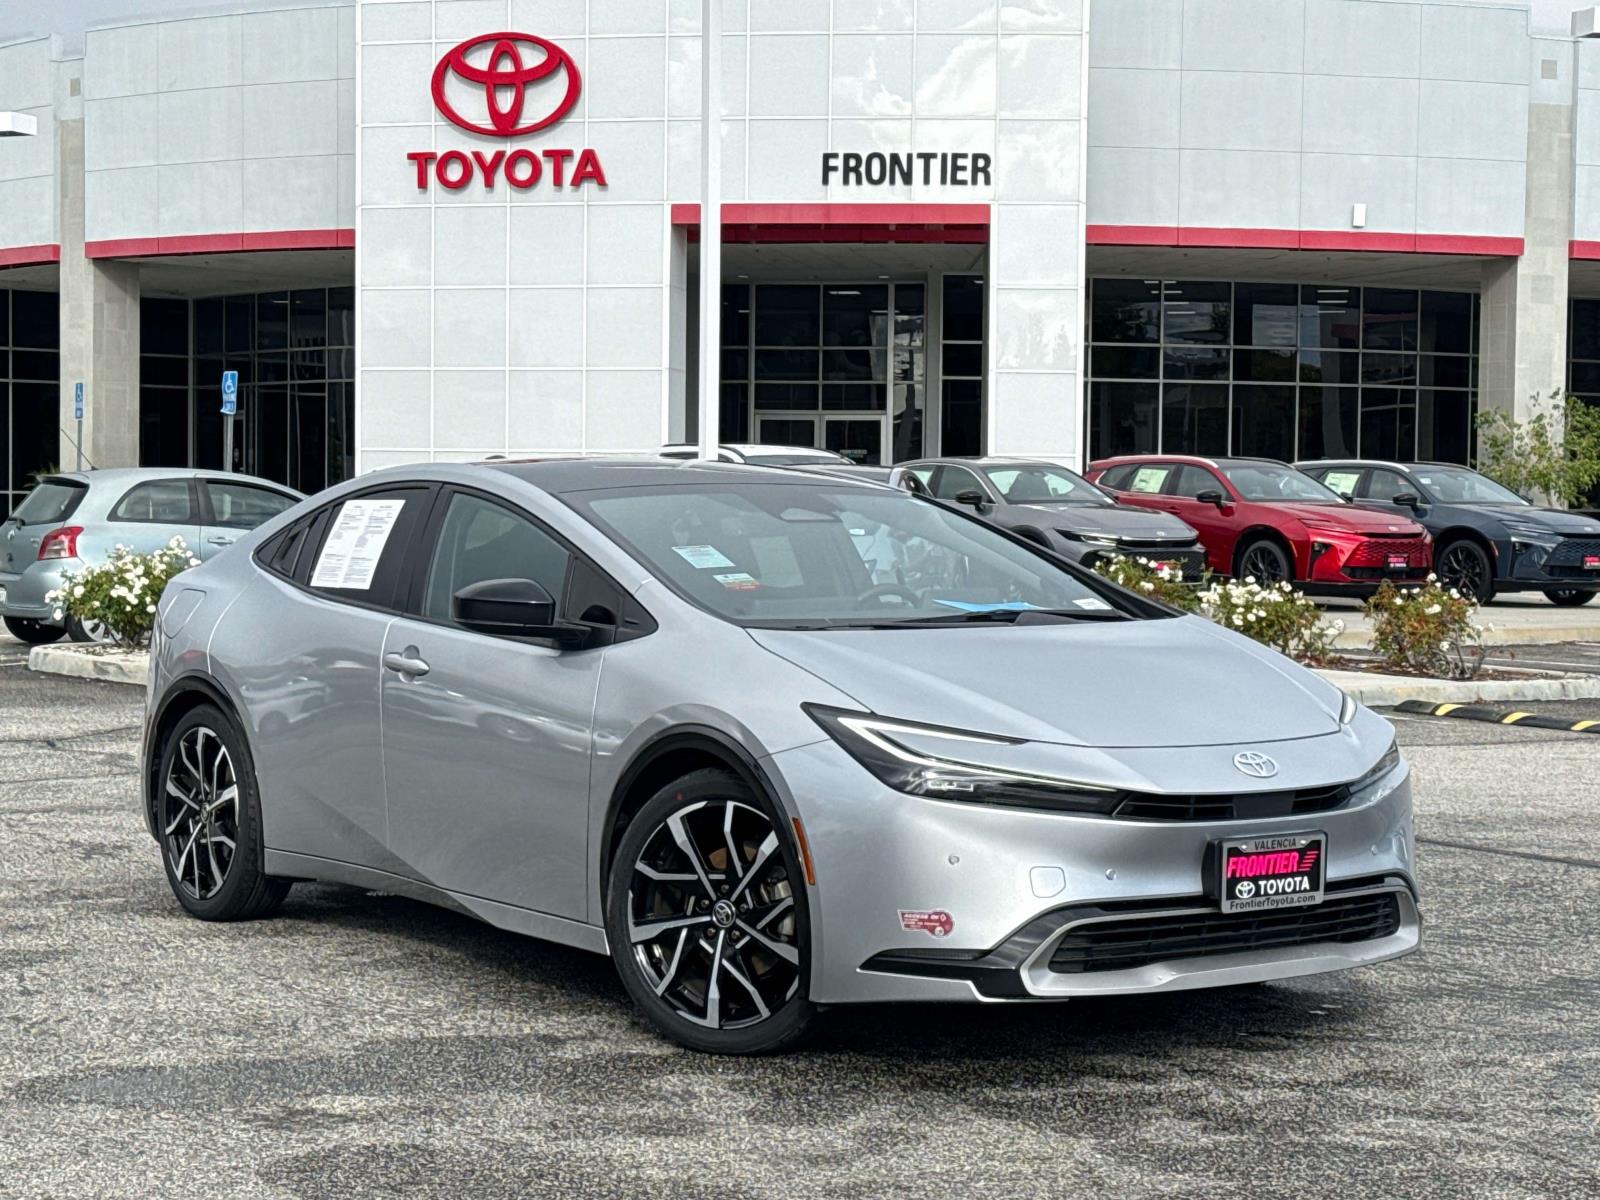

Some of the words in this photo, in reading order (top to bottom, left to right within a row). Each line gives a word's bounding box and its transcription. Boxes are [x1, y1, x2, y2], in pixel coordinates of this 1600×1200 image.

[407, 149, 608, 190] TOYOTA
[822, 152, 992, 186] FRONTIER
[1254, 838, 1297, 850] VALENCIA
[1227, 852, 1300, 878] FRONTIER
[1258, 876, 1310, 895] TOYOTA
[1230, 895, 1316, 911] FrontierToyota.com
